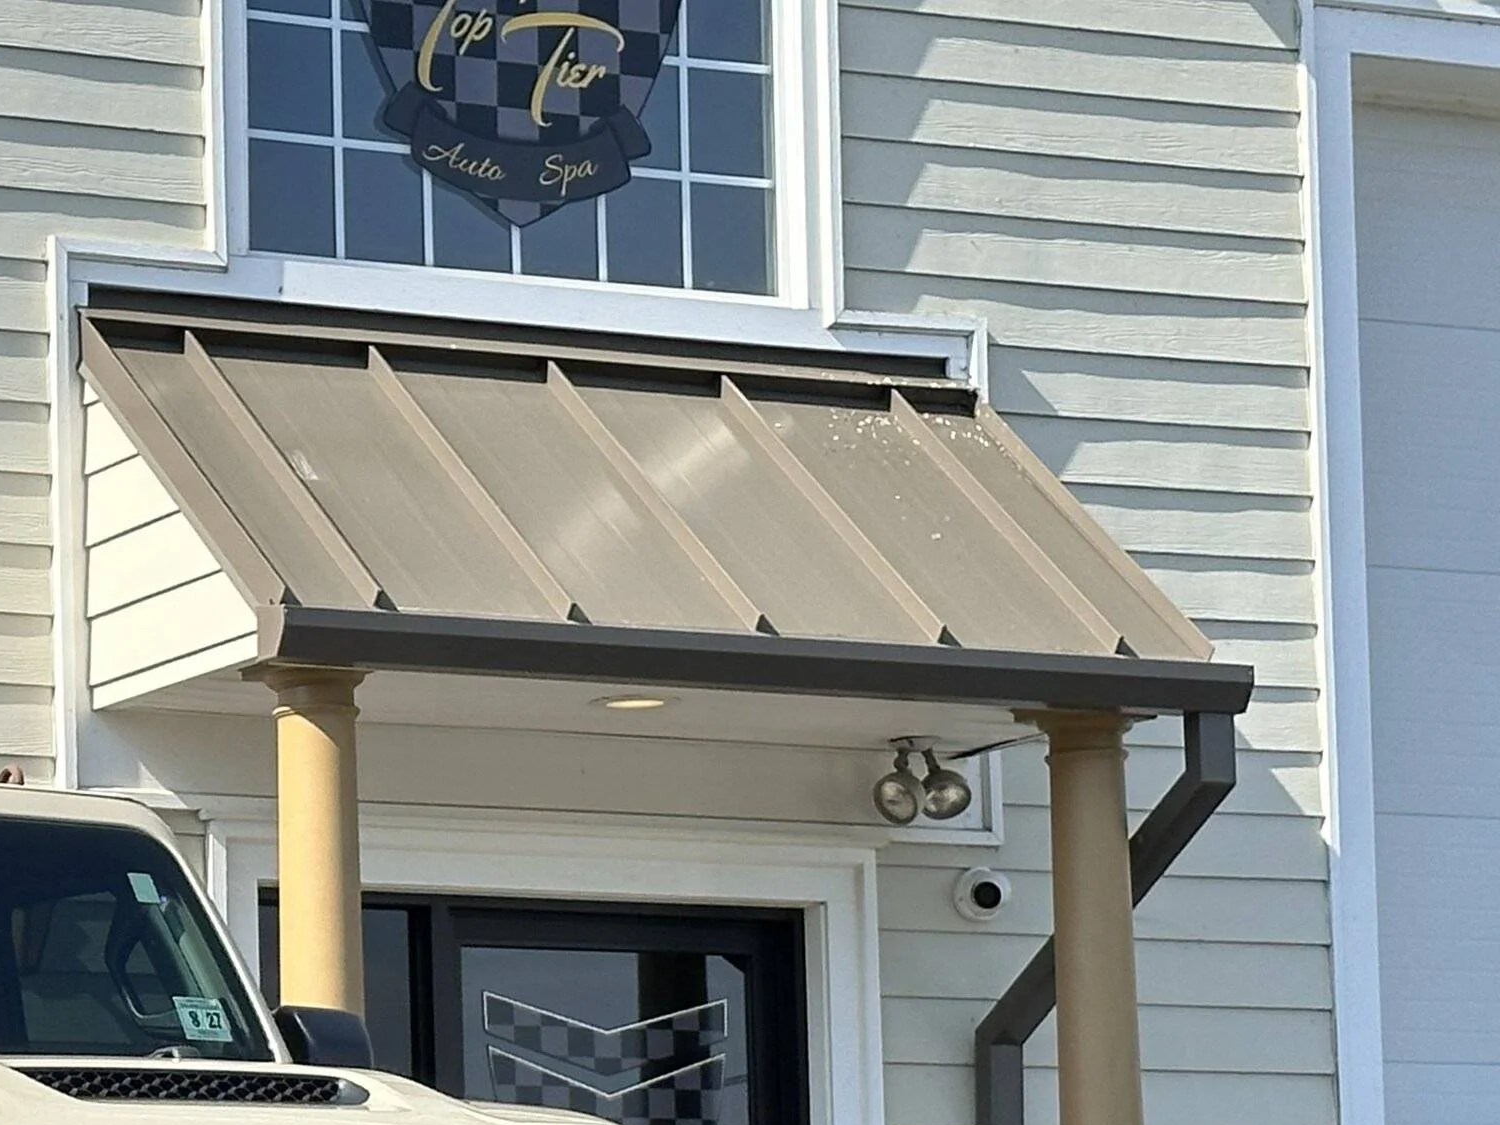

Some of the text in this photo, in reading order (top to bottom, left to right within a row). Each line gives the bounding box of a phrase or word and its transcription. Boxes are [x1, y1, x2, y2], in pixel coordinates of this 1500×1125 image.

[501, 12, 625, 127] Tier
[422, 143, 597, 197] Auto Spa
[188, 1010, 201, 1028] 8
